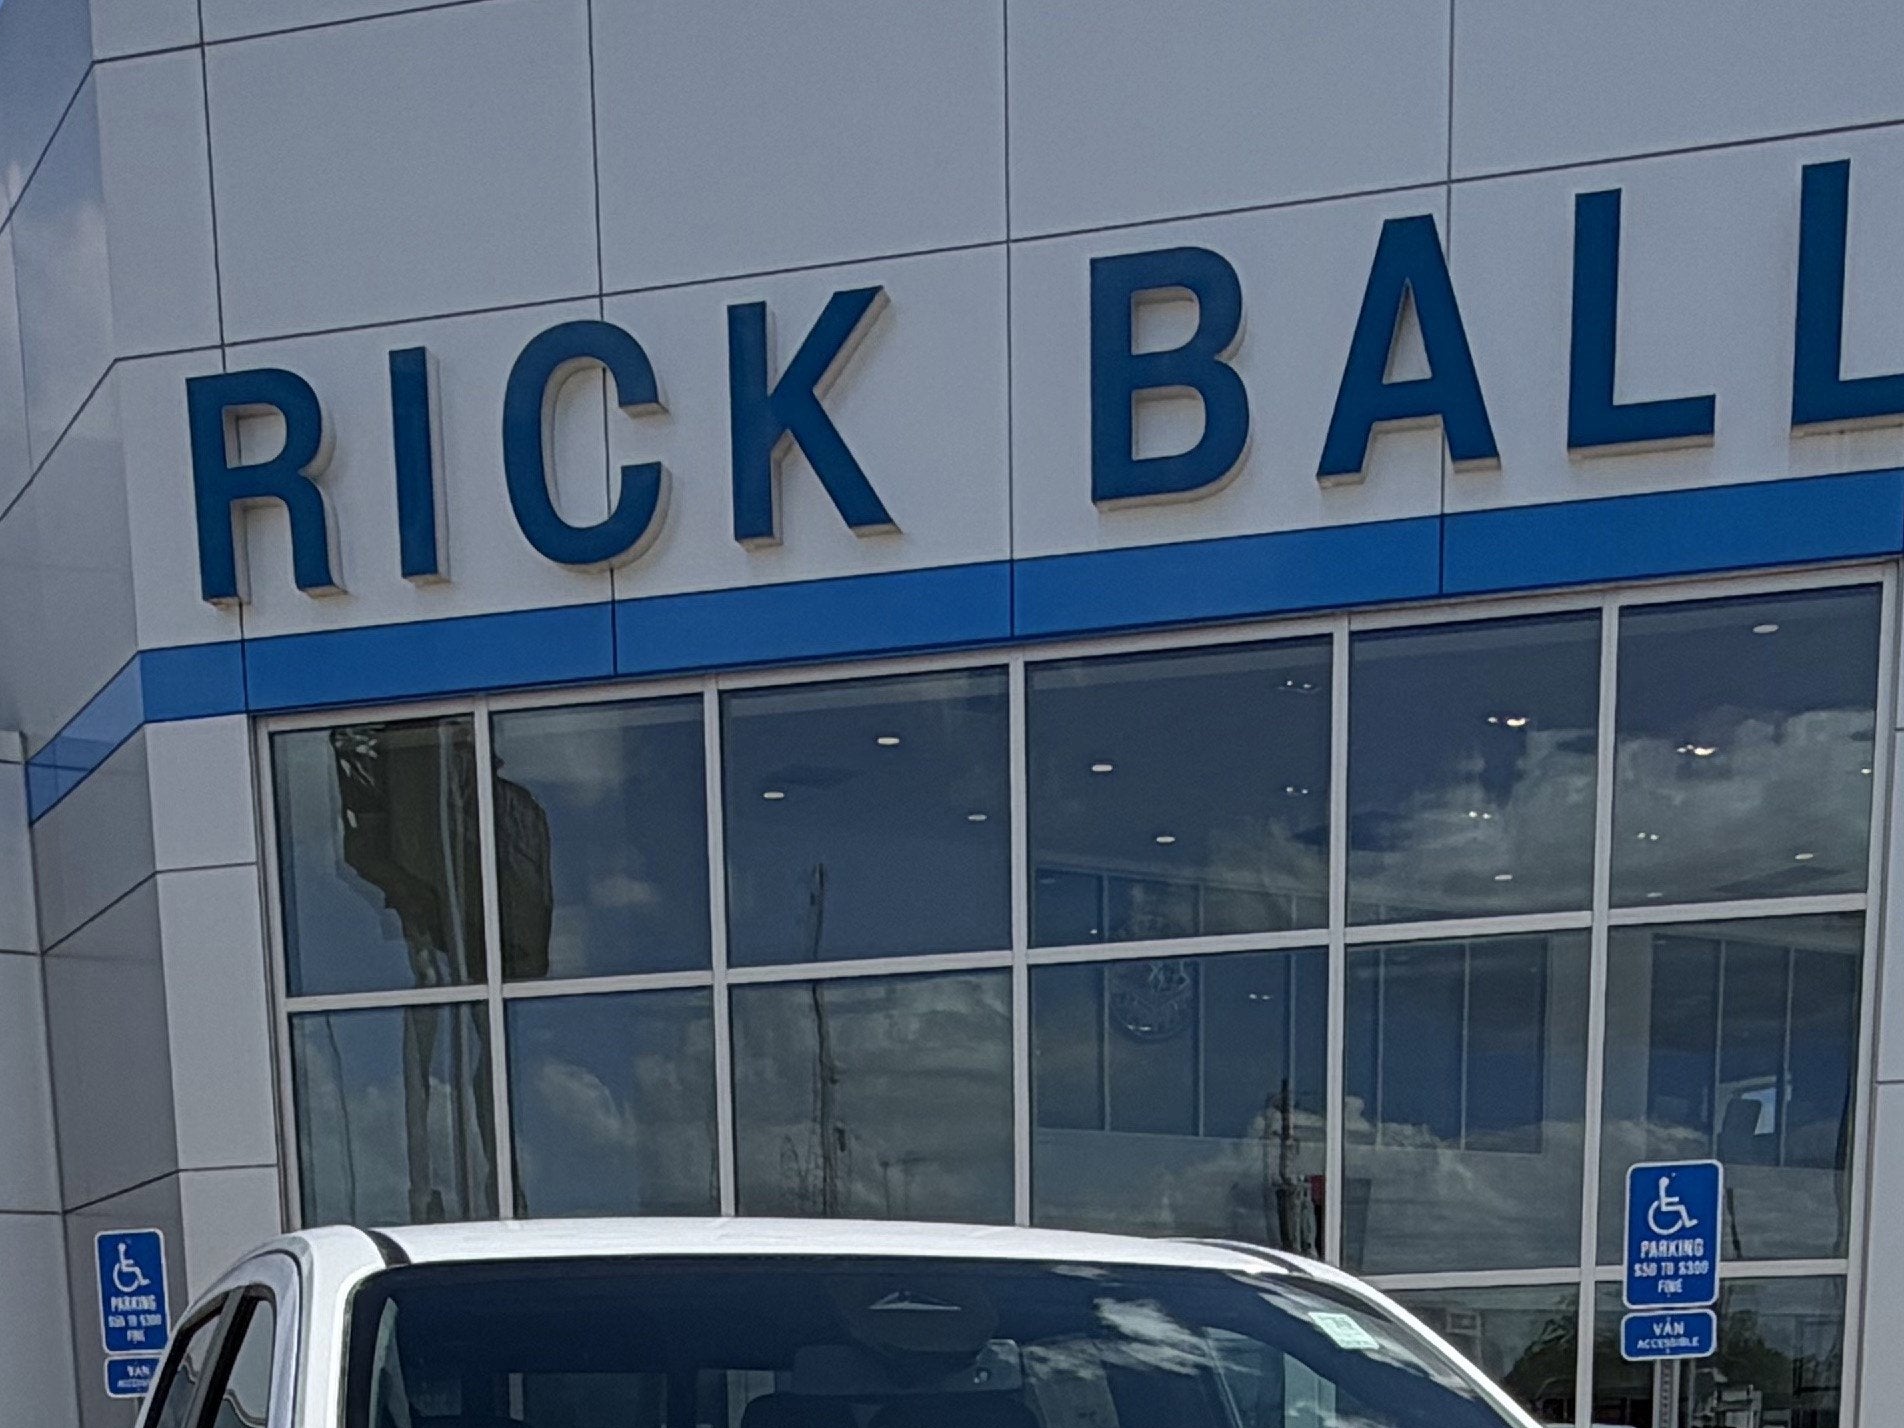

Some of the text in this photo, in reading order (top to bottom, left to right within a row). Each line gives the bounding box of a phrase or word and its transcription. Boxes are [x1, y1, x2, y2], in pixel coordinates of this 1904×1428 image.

[186, 287, 894, 604] RICK
[1640, 1238, 1704, 1259] PARKING
[1634, 1262, 1657, 1277] $50
[1661, 1262, 1675, 1276] TO
[1653, 1320, 1685, 1336] VAN
